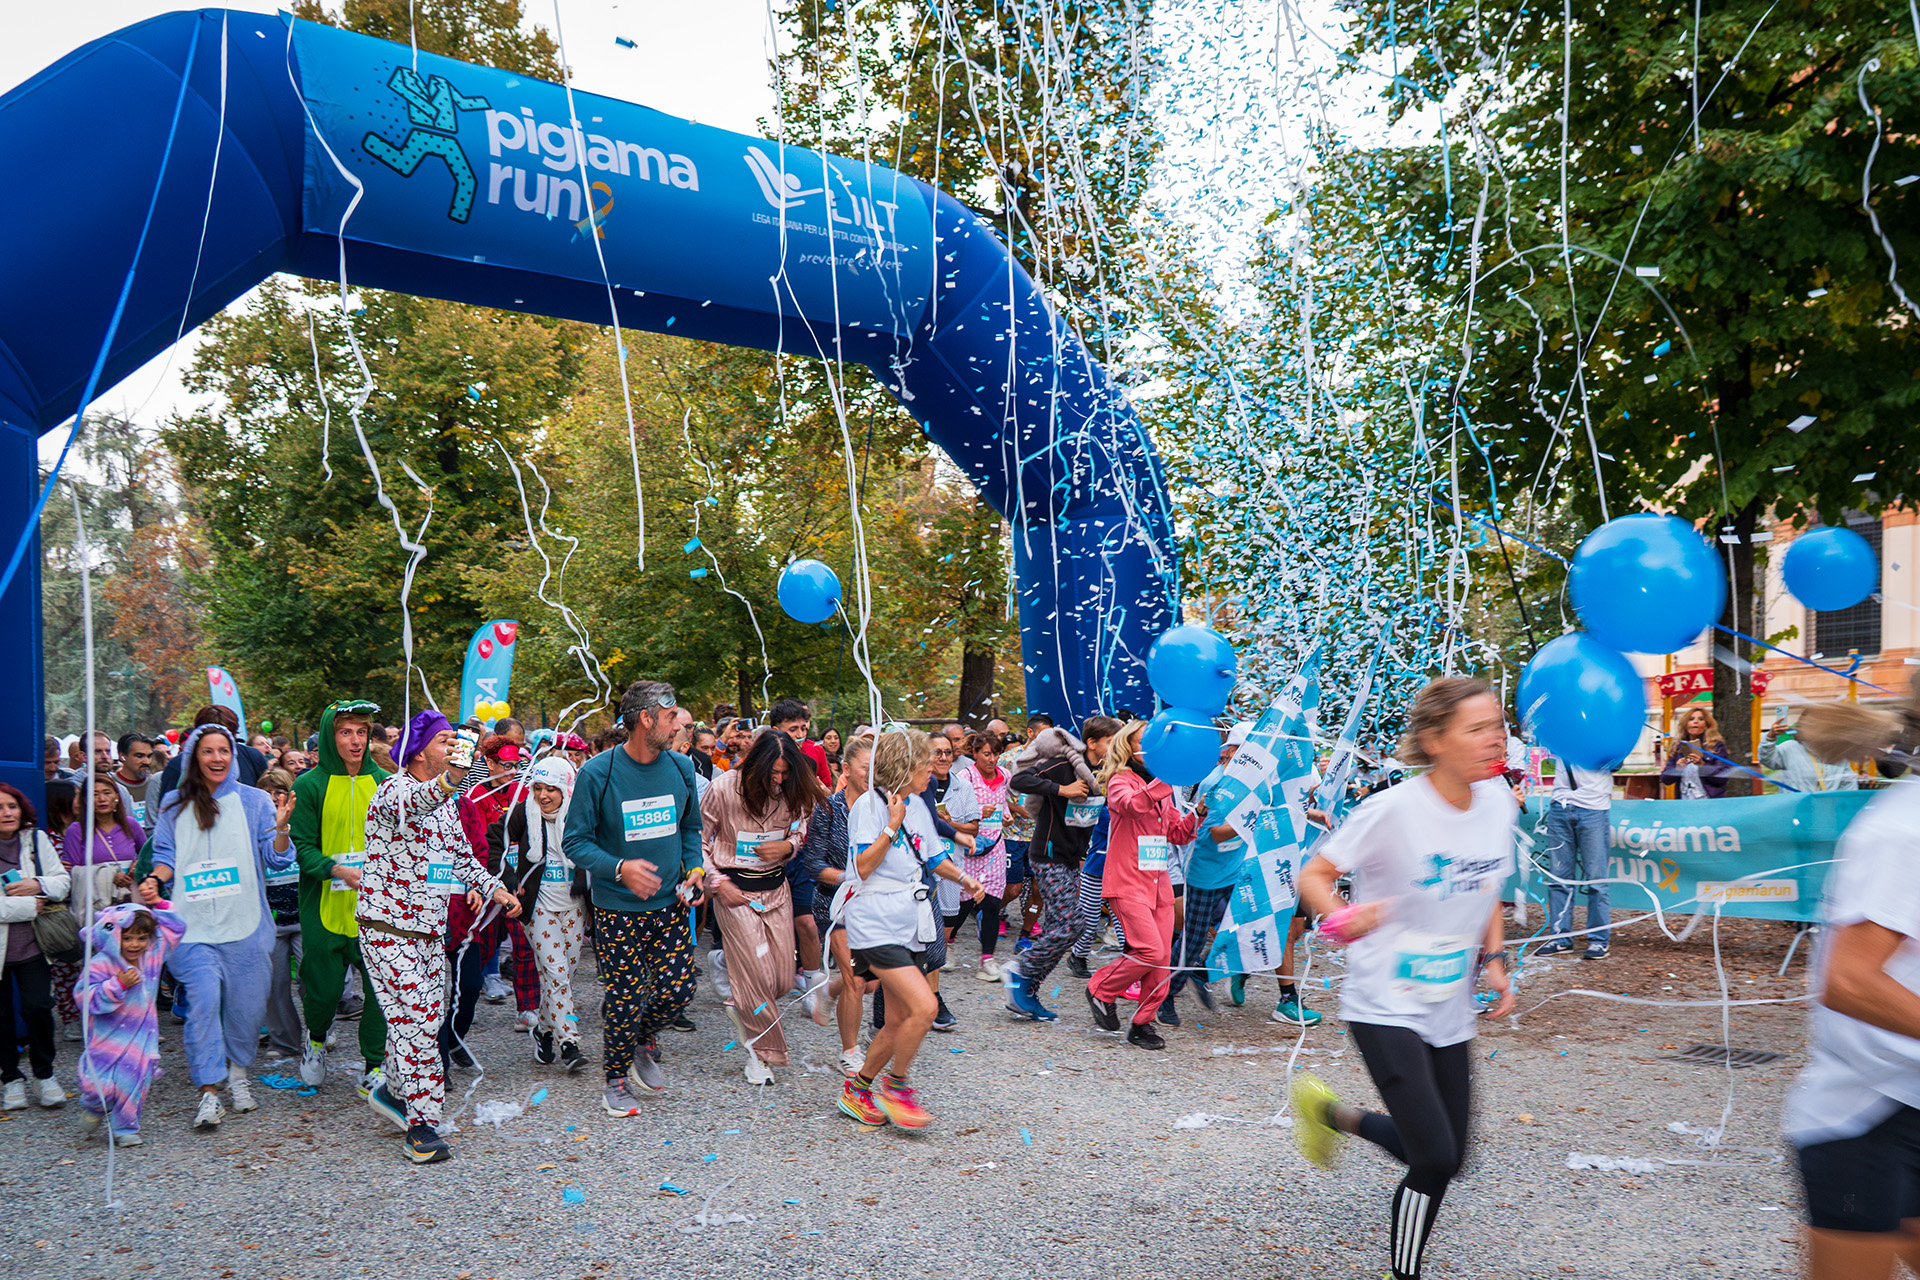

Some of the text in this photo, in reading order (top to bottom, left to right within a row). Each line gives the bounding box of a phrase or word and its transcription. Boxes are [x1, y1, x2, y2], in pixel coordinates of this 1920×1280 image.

[485, 106, 700, 192] pigiama
[488, 162, 582, 222] run
[752, 212, 771, 225] LEGA
[804, 223, 817, 235] PER
[818, 226, 828, 237] LA
[831, 229, 848, 241] OTTA
[868, 259, 904, 271] vvere
[1673, 673, 1713, 692] FA
[630, 809, 671, 827] 15886
[190, 870, 232, 888] 14441
